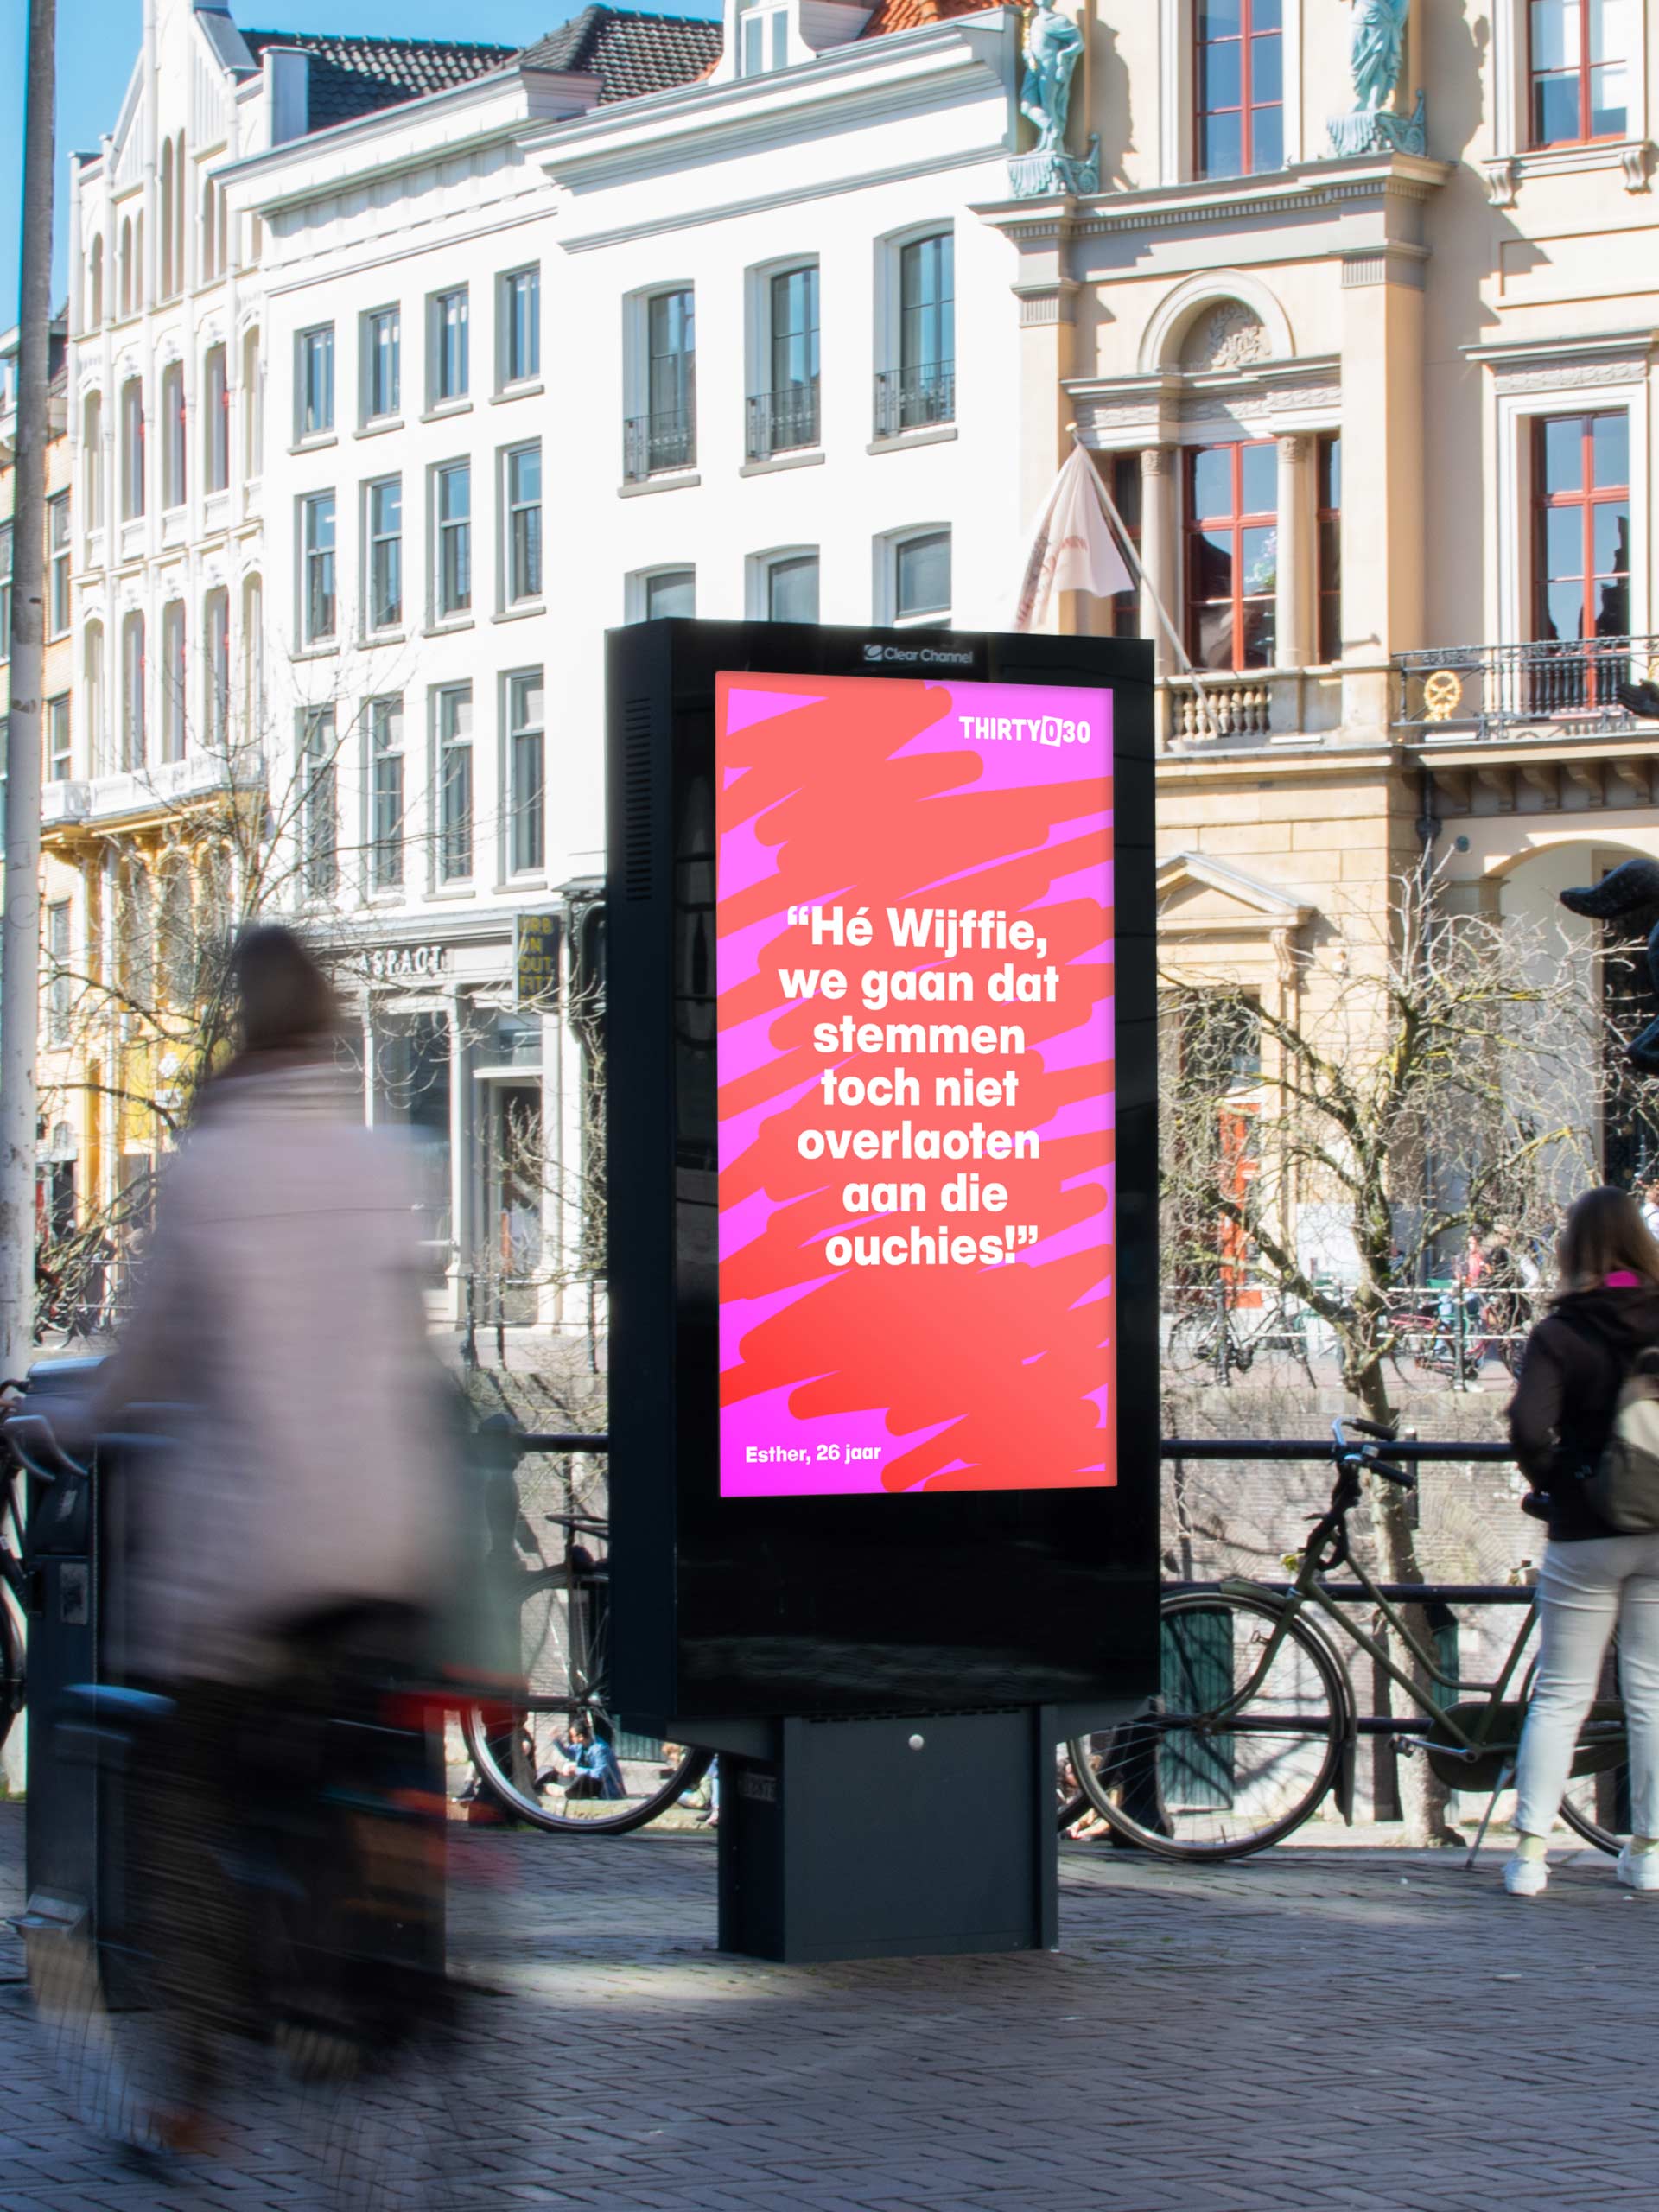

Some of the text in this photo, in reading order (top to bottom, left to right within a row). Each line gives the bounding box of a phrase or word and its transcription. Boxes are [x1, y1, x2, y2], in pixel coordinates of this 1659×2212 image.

[883, 646, 974, 664] Clear Channel
[787, 906, 1048, 960] “Hé Wijffie,
[518, 955, 552, 973] OUT
[779, 963, 1060, 1011] we gaan dat
[813, 1015, 1027, 1055] stemmen
[821, 1067, 1019, 1108] toch niet
[797, 1120, 1040, 1160] overlaoten
[842, 1173, 1008, 1213] aan die
[825, 1225, 1039, 1267] ouchies!”
[746, 1444, 882, 1465] Esther, 26 jaar
